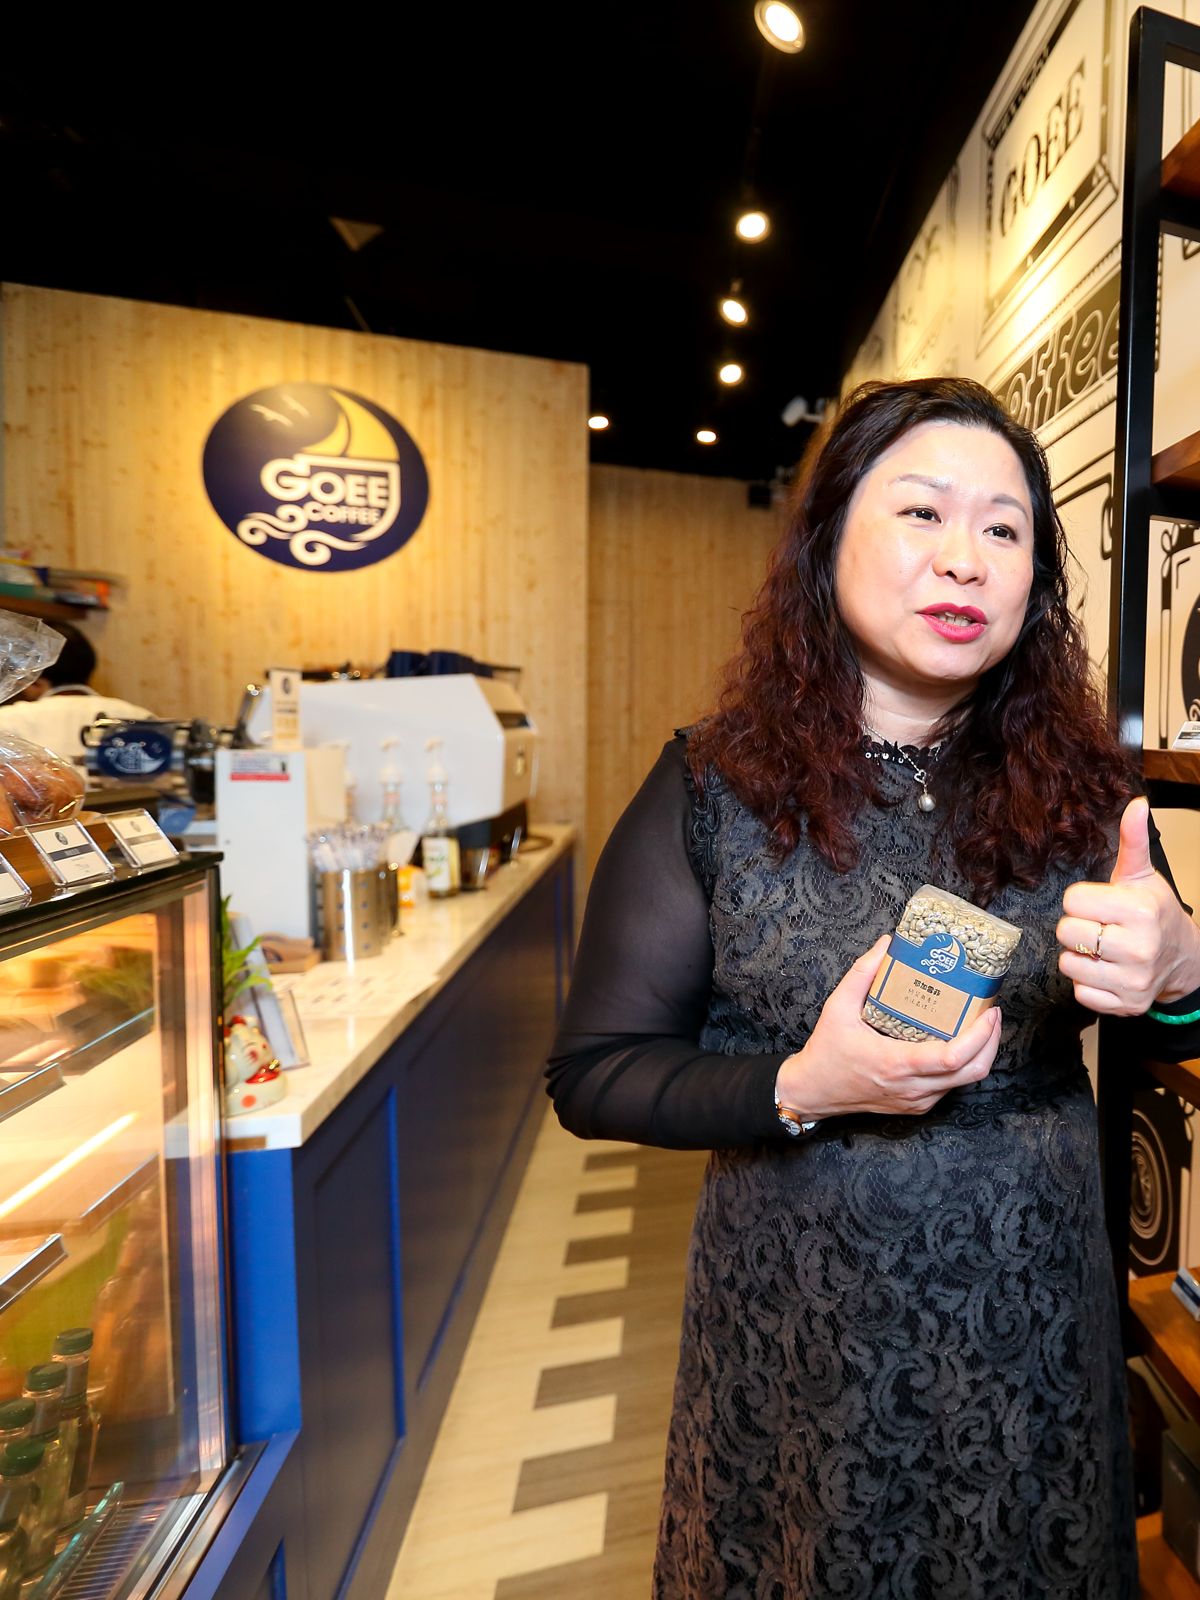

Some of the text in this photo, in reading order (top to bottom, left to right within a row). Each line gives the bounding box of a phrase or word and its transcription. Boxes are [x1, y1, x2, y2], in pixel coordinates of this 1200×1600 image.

[1000, 56, 1085, 237] GOEE
[260, 456, 389, 508] GOEE
[304, 501, 381, 526] COFFEE
[930, 949, 956, 966] GOEE
